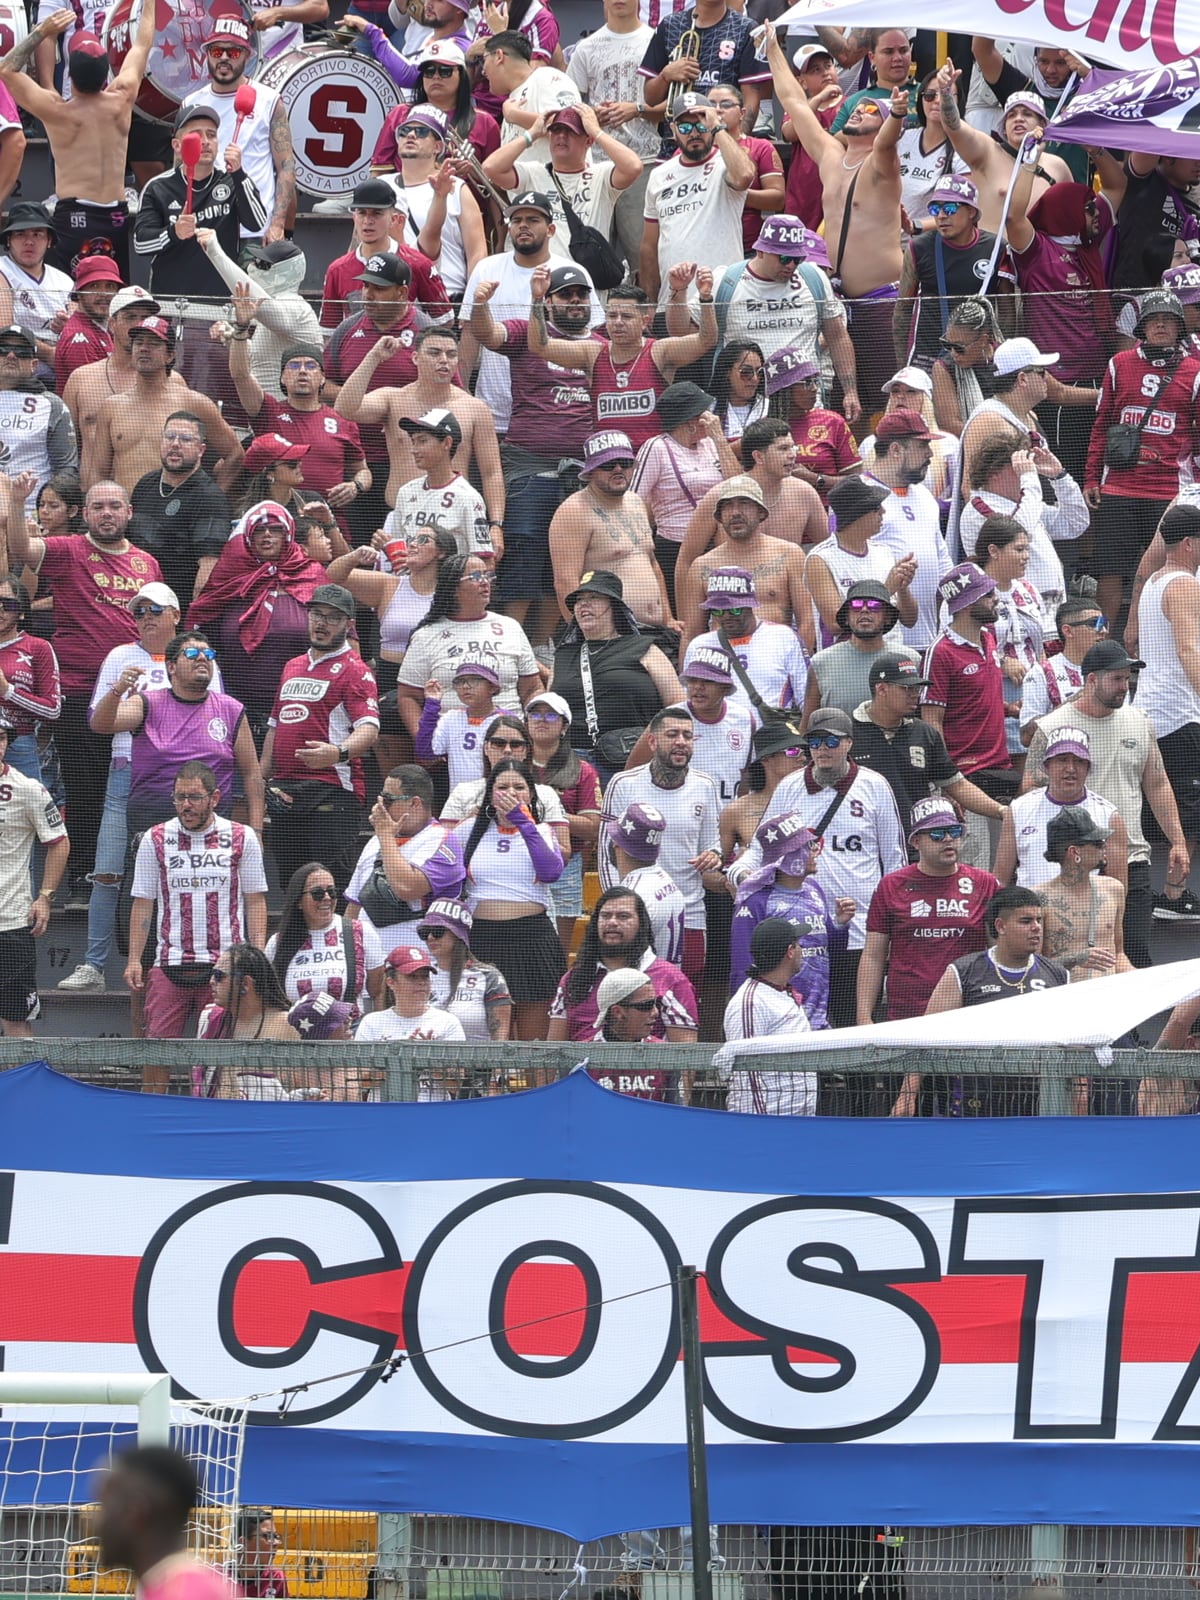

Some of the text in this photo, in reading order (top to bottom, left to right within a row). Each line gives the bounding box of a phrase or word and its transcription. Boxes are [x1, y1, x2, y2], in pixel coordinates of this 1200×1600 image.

[719, 40, 735, 60] S
[282, 60, 347, 108] DEPORTIVO
[683, 92, 697, 107] S
[304, 84, 368, 168] S
[704, 161, 714, 175] S
[936, 156, 946, 170] S
[342, 167, 368, 189] RIC
[912, 166, 934, 179] BAC
[574, 187, 592, 202] AC
[678, 182, 707, 197] BAC
[169, 204, 231, 225] SSUNG
[659, 201, 704, 218] LIBERTY
[767, 298, 802, 311] BAC
[747, 316, 804, 331] LIBERTY
[1141, 374, 1160, 397] S
[23, 397, 36, 414] S
[599, 394, 651, 412] BIMBO
[325, 417, 337, 434] S
[441, 491, 454, 508] S
[416, 511, 446, 526] BAC
[903, 504, 915, 521] S
[111, 575, 146, 590] BAC
[490, 622, 504, 636] S
[330, 662, 342, 674] S
[150, 669, 164, 684] S
[281, 681, 326, 697] BIMBO
[463, 731, 477, 750] S
[909, 746, 925, 767] S
[695, 804, 703, 816] S
[850, 800, 864, 817] S
[219, 832, 232, 849] S
[496, 839, 510, 852] S
[832, 835, 862, 851] LG
[190, 853, 227, 870] BAC
[171, 875, 228, 888] LIBERTY
[958, 877, 973, 895] S
[936, 898, 969, 912] BAC
[914, 927, 965, 938] LIBERTY
[46, 946, 71, 967] 17
[313, 951, 344, 963] BAC
[466, 976, 477, 988] S
[619, 1075, 655, 1091] BAC
